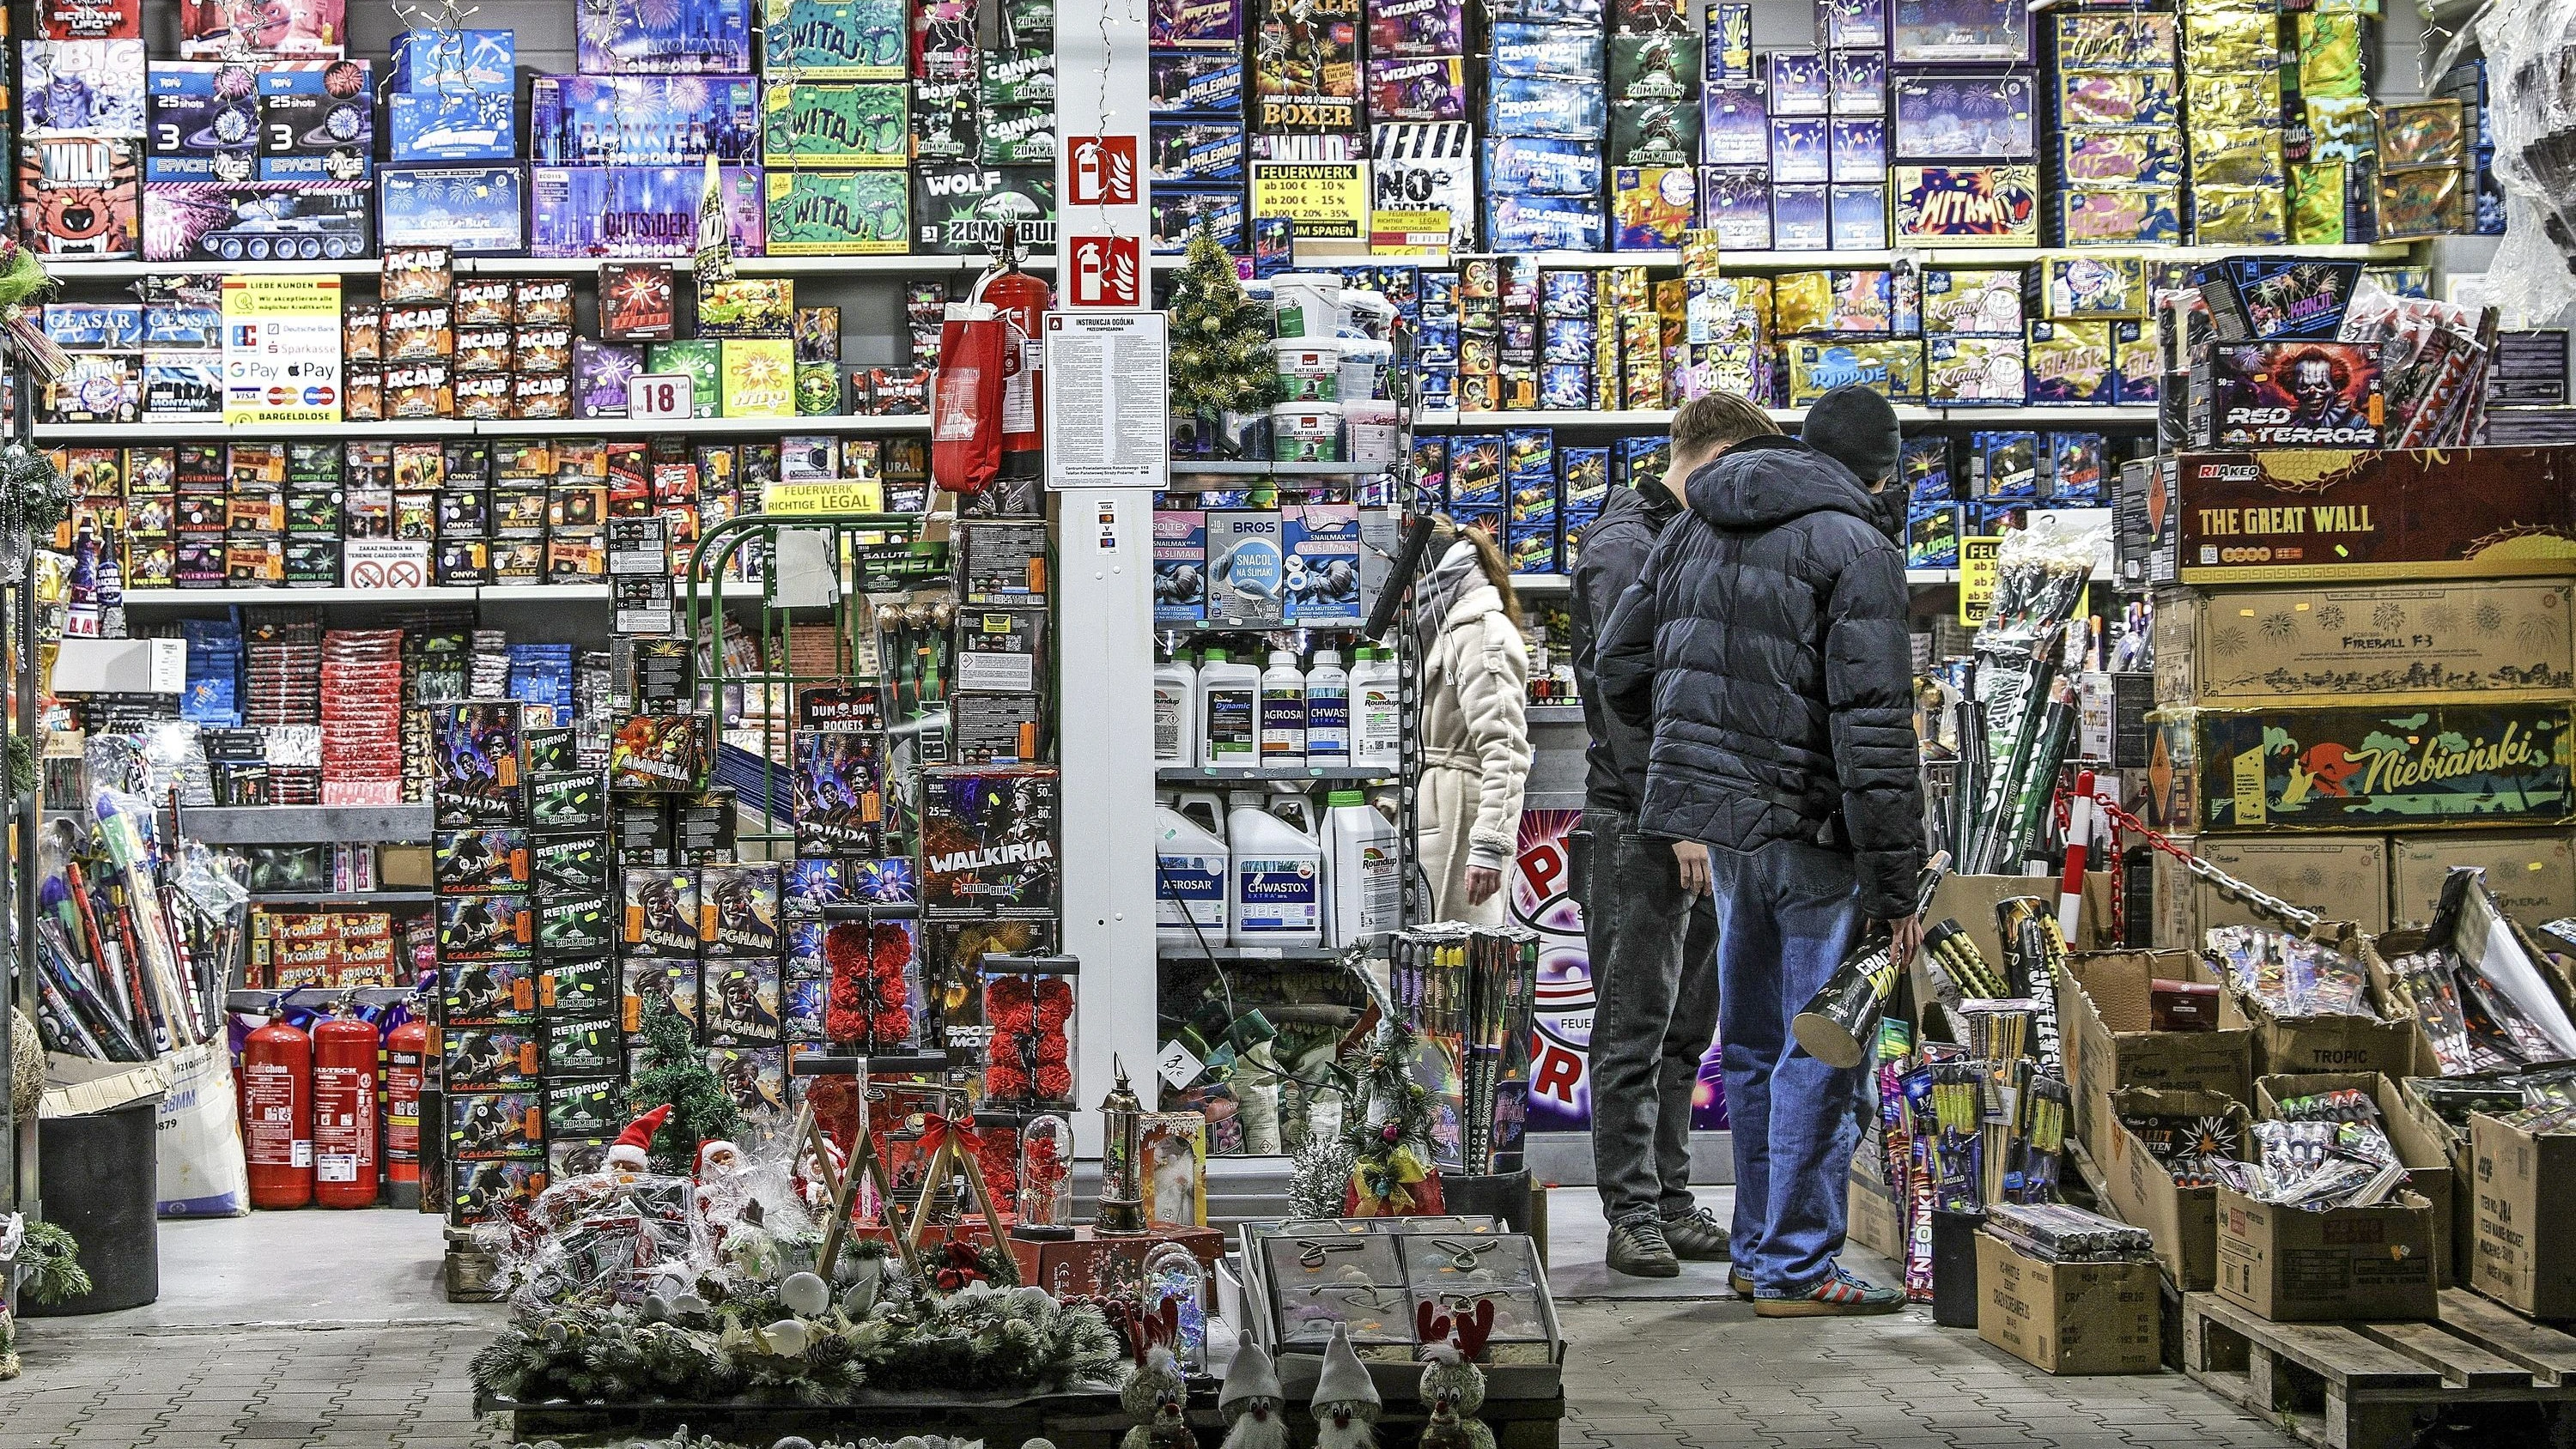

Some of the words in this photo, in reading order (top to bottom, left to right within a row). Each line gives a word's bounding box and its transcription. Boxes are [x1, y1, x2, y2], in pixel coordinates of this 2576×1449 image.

[1378, 2, 1435, 17] WIZARD
[60, 42, 145, 71] BIG
[1001, 73, 1026, 83] SHOT
[1380, 62, 1438, 81] WIZARD
[1188, 74, 1241, 98] PALERMO
[158, 95, 179, 108] 25
[270, 95, 290, 108] 25
[1498, 100, 1569, 117] PROXIMO
[1264, 105, 1352, 126] BOXER
[157, 124, 179, 150] 3
[270, 124, 292, 150] 3
[581, 122, 708, 149] BANKIER
[1189, 143, 1241, 167] PALERMO
[1271, 135, 1345, 161] WILD
[43, 143, 110, 180] WILD
[271, 158, 321, 172] SPACE
[322, 157, 363, 171] RACE
[1515, 149, 1595, 170] COLOSSEUM
[1261, 167, 1352, 179] FEUERWERK
[927, 172, 1001, 196] WOLF
[331, 197, 364, 209] TANK
[1918, 191, 2006, 227] WITAM!
[1518, 207, 1598, 228] COLOSSEUM
[1315, 227, 1353, 235] SPAREN
[387, 251, 447, 271] ACAB
[2289, 294, 2332, 319] KANJI
[389, 308, 447, 330] ACAB
[1112, 317, 1134, 325] OGÓLNA
[282, 344, 335, 355] Sparkasse
[305, 362, 334, 380] Pay
[1696, 368, 1751, 391] RAUSZ
[642, 384, 675, 413] 18
[2227, 408, 2291, 425] RED
[2257, 427, 2378, 444] TERROR
[1521, 448, 1551, 465] TRICOLOR
[2002, 469, 2035, 485] SCORPIO
[2198, 464, 2258, 477] RIAKEO
[785, 485, 853, 494] FEUERWERK
[1465, 474, 1500, 493] CAROLUS
[769, 501, 815, 510] RICHTIGE
[822, 494, 870, 508] LEGAL
[1524, 499, 1555, 512] TRICOLOR
[1233, 522, 1275, 533] BROS
[2199, 507, 2240, 536] THE
[2245, 506, 2308, 534] GREAT
[2312, 504, 2374, 533] WALL
[1164, 548, 1199, 558] ŚLIMAKI
[1315, 542, 1353, 553] ŚLIMAKI
[1927, 535, 1956, 554] OPAL
[863, 551, 912, 560] SALUTE
[1237, 554, 1272, 567] SNACOL
[451, 571, 477, 579] ONYX
[1236, 568, 1245, 577] NA
[1248, 567, 1273, 577] ŚLIMAKI
[2342, 635, 2405, 649] FIREBALL
[2412, 634, 2433, 648] F3
[812, 706, 835, 717] DUM
[852, 704, 874, 715] BUM
[1215, 702, 1250, 711] Dynamic
[1365, 699, 1399, 707] Roundup
[823, 719, 863, 731] ROCKETS
[2344, 721, 2533, 795] Niebiański
[621, 755, 690, 781] AMNESIA
[535, 776, 595, 795] RETORNO
[1036, 788, 1048, 797] 50
[439, 791, 511, 816] TRIADA
[928, 807, 939, 815] 25
[1037, 809, 1049, 819] 80
[798, 821, 871, 842] TRIADA
[537, 839, 595, 858] RETORNO
[928, 840, 1054, 873] WALKIRIA
[1363, 858, 1397, 870] Roundup
[961, 883, 989, 894] COLOR
[990, 886, 1011, 896] BUM
[1163, 880, 1212, 890] AGROSAR
[1249, 882, 1308, 893] CHWASTOX
[544, 900, 601, 918] RETORNO
[642, 929, 696, 949] FGHAN
[283, 968, 313, 980] BRAVO
[316, 966, 325, 977] XL
[712, 1020, 777, 1040] AFGHAN
[2030, 969, 2060, 1075] GATLING
[393, 1053, 416, 1064] chron
[2313, 1050, 2368, 1064] TROPIC
[1944, 1174, 1965, 1184] MOSAD
[1912, 1190, 1933, 1274] NEONKI
